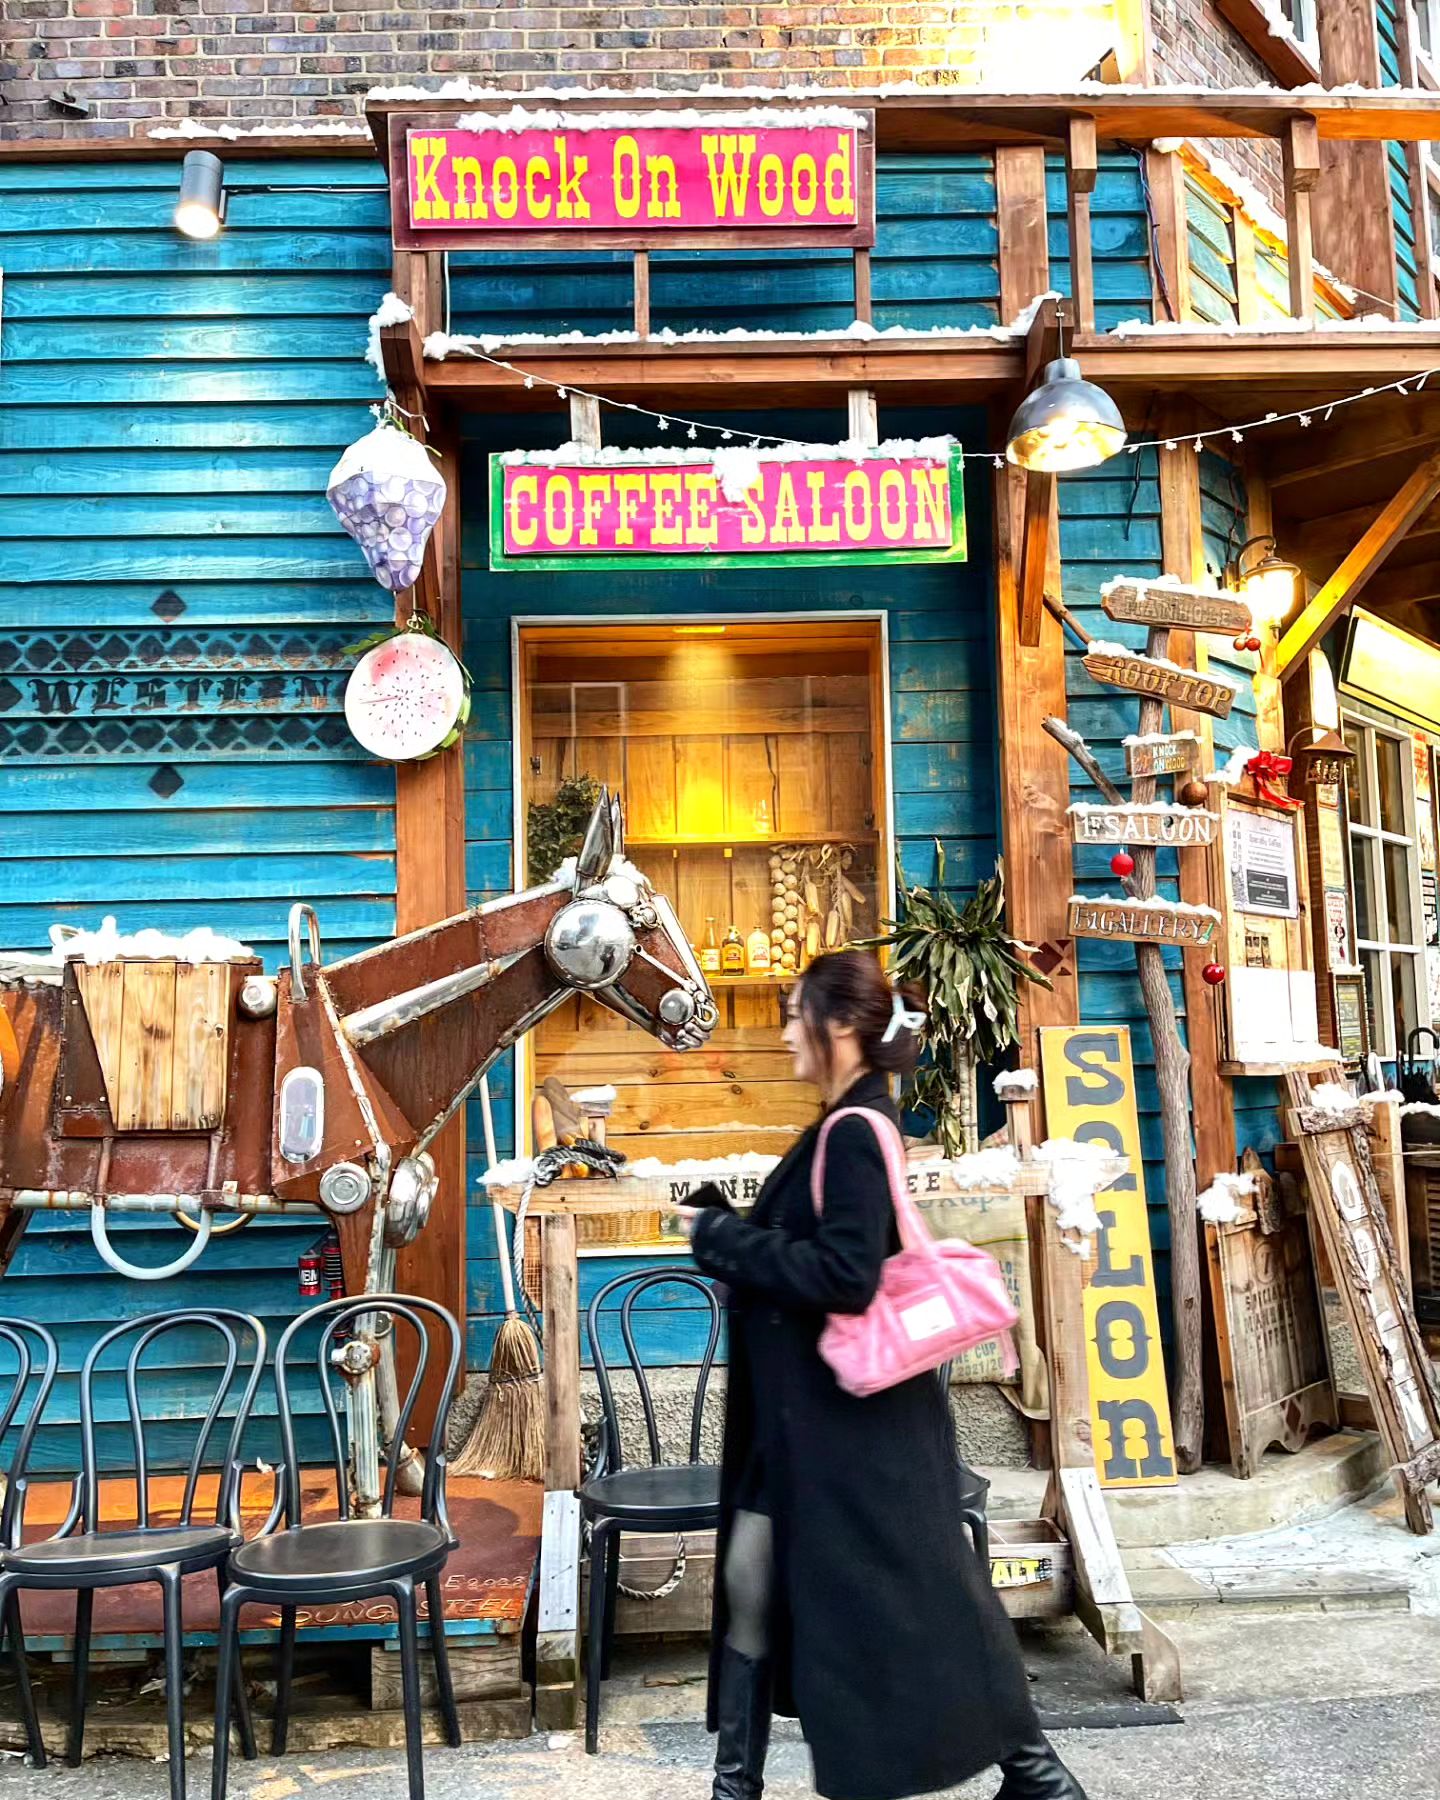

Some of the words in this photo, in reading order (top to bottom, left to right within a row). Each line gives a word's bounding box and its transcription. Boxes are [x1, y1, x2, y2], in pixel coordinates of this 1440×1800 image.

[411, 136, 590, 219] Knock
[612, 135, 681, 218] On
[701, 133, 854, 217] Wood
[510, 473, 719, 546] COFFEE
[741, 467, 948, 543] SALOON
